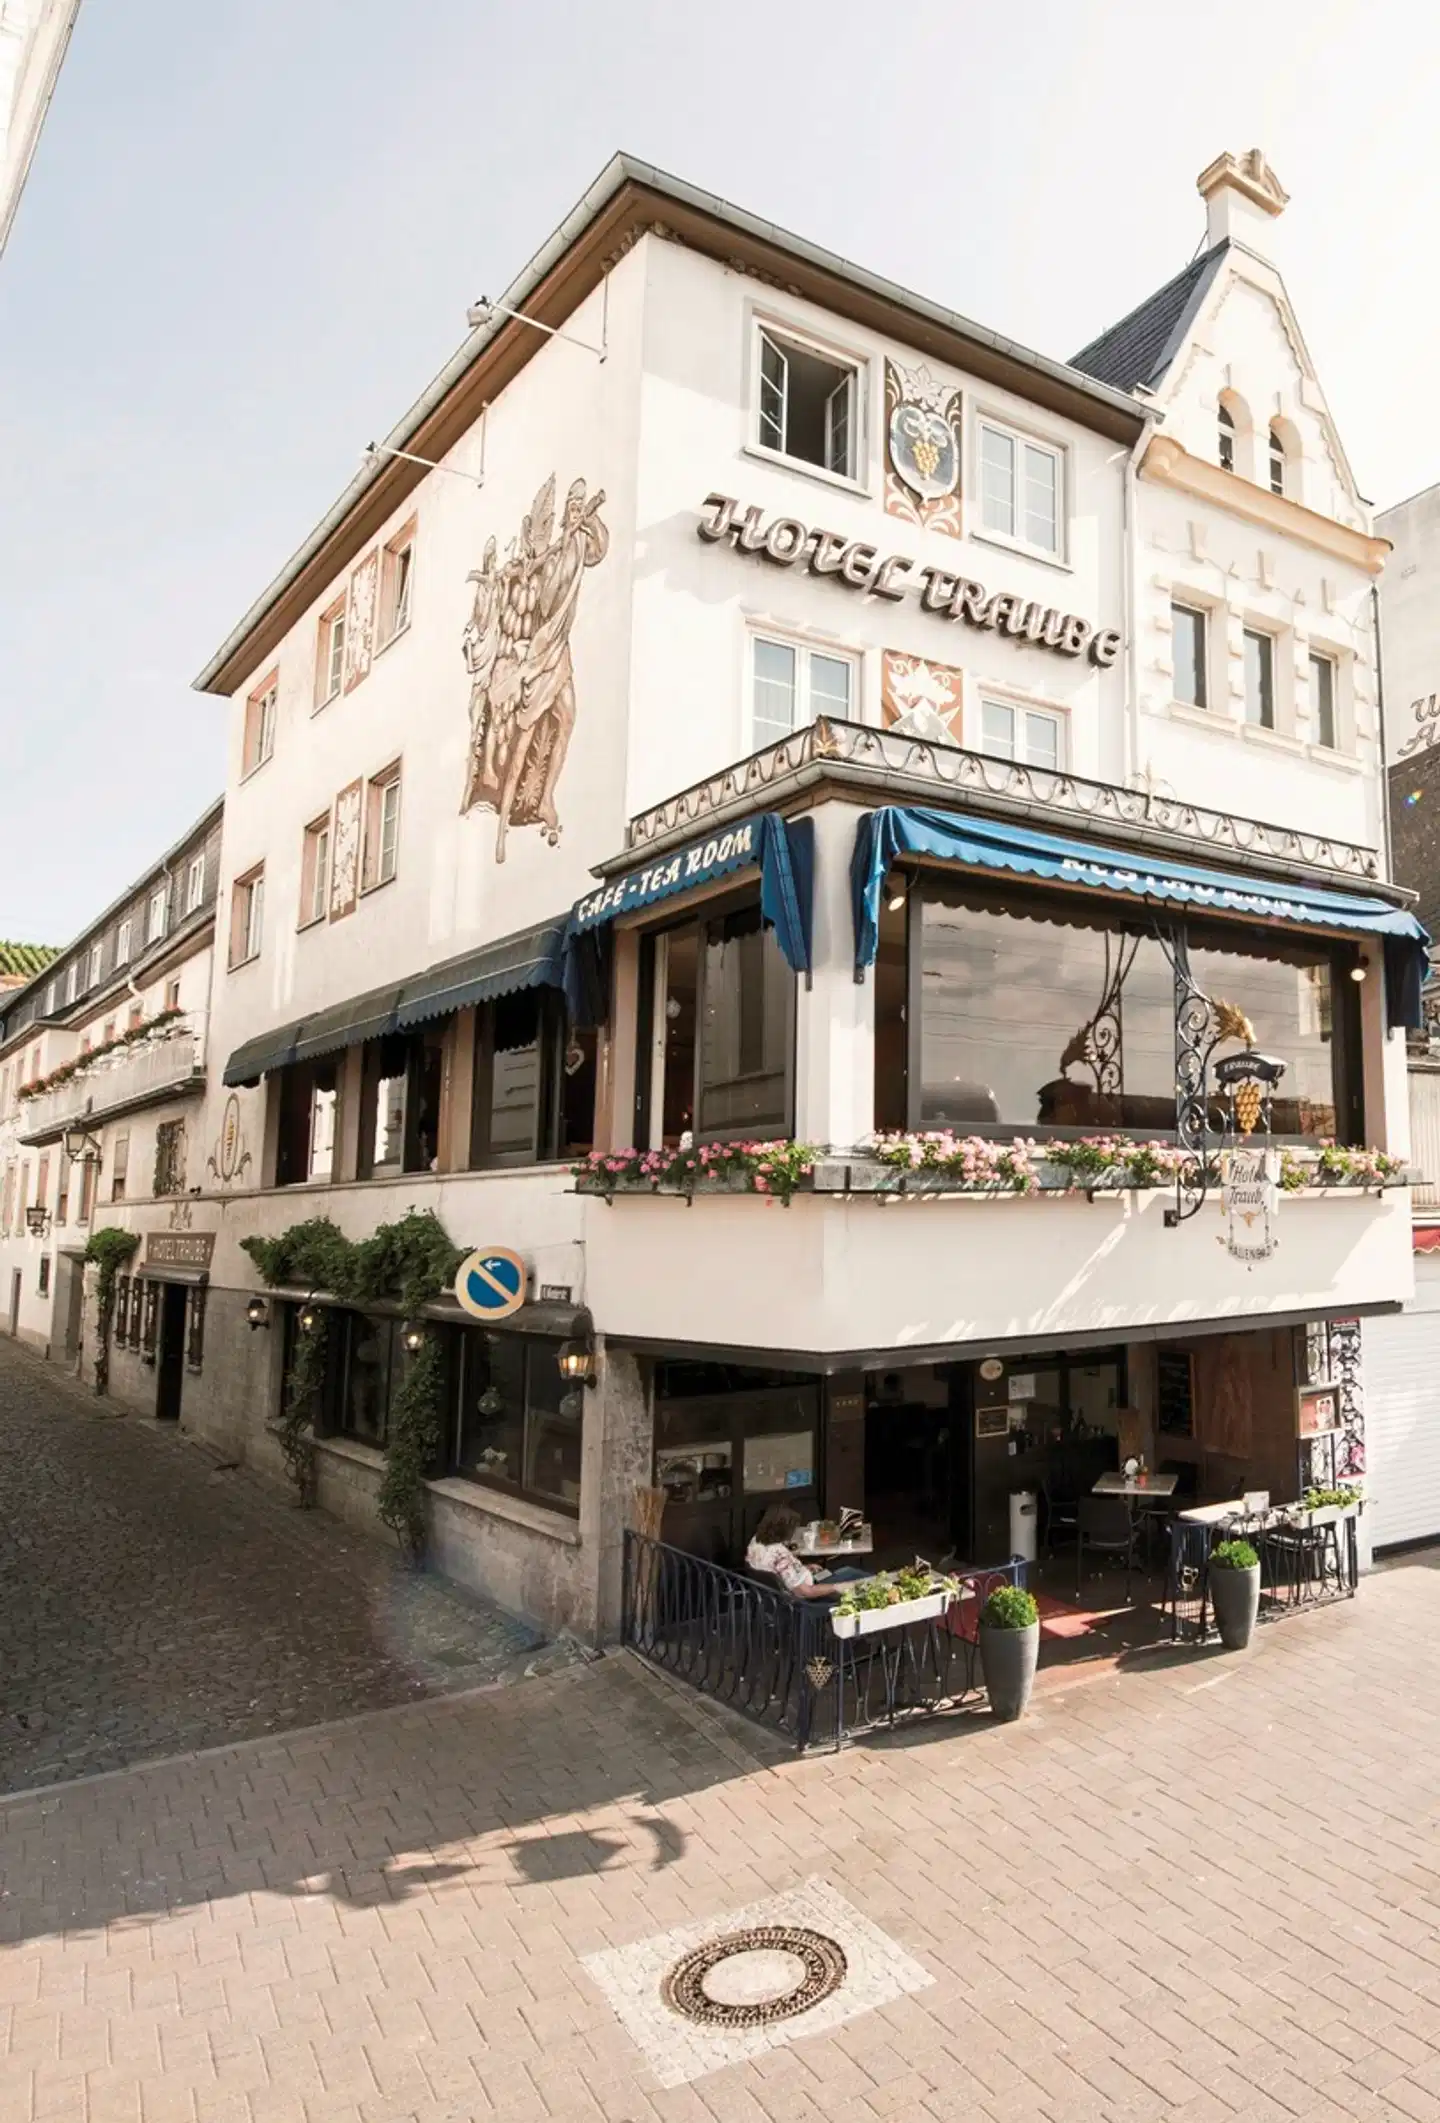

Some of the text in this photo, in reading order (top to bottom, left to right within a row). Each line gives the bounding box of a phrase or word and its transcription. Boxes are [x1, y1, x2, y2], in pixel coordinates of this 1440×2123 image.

[698, 492, 1123, 668] HOTEL TRAUBE
[639, 858, 681, 895] TEA
[684, 825, 752, 876] ROOM
[1229, 1184, 1264, 1206] Traub
